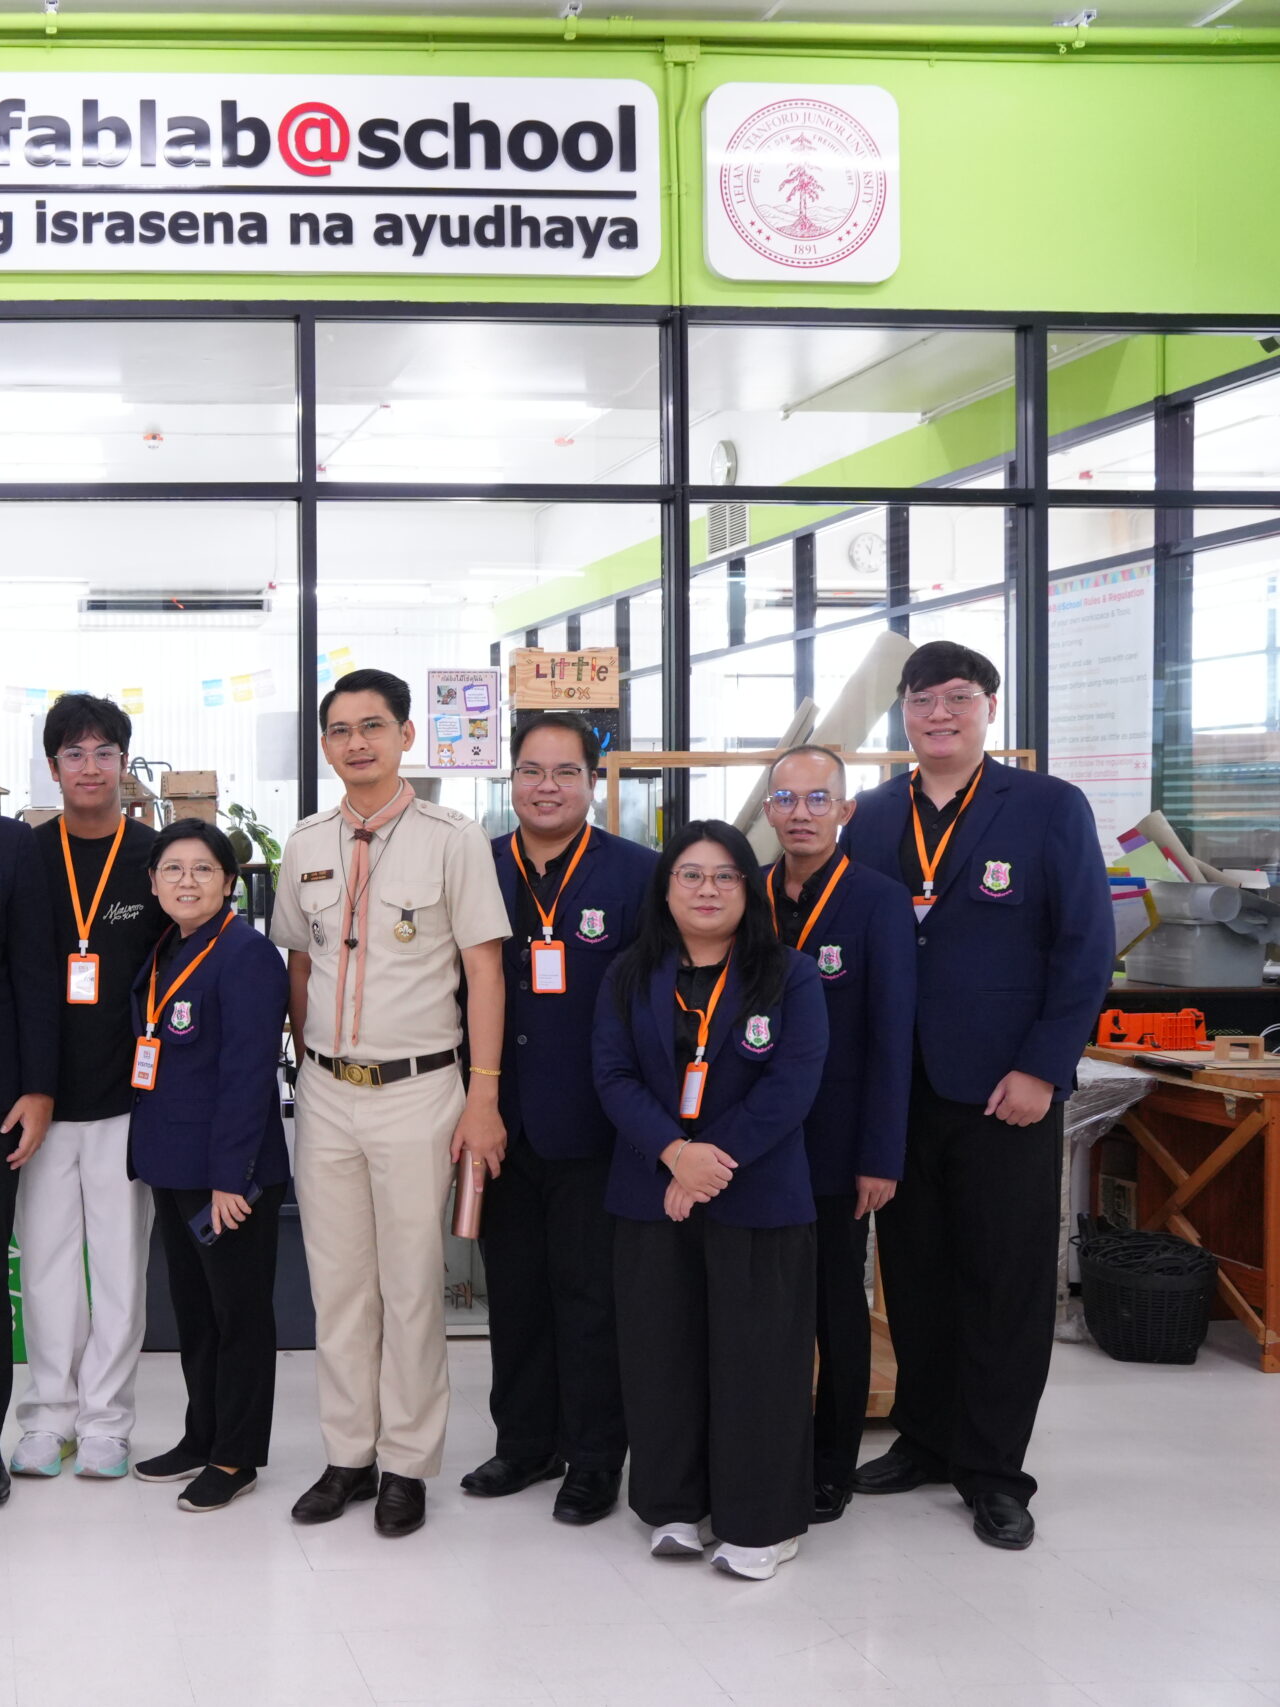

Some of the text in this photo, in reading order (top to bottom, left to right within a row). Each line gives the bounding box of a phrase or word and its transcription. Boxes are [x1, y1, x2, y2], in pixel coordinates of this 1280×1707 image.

[742, 111, 799, 151] STANFORD
[803, 111, 846, 136] JUNIOR
[845, 132, 875, 205] UNIRSITY
[35, 200, 268, 245] israsena
[289, 212, 354, 246] na
[372, 205, 639, 259] ayudhaya
[793, 244, 817, 255] 1891
